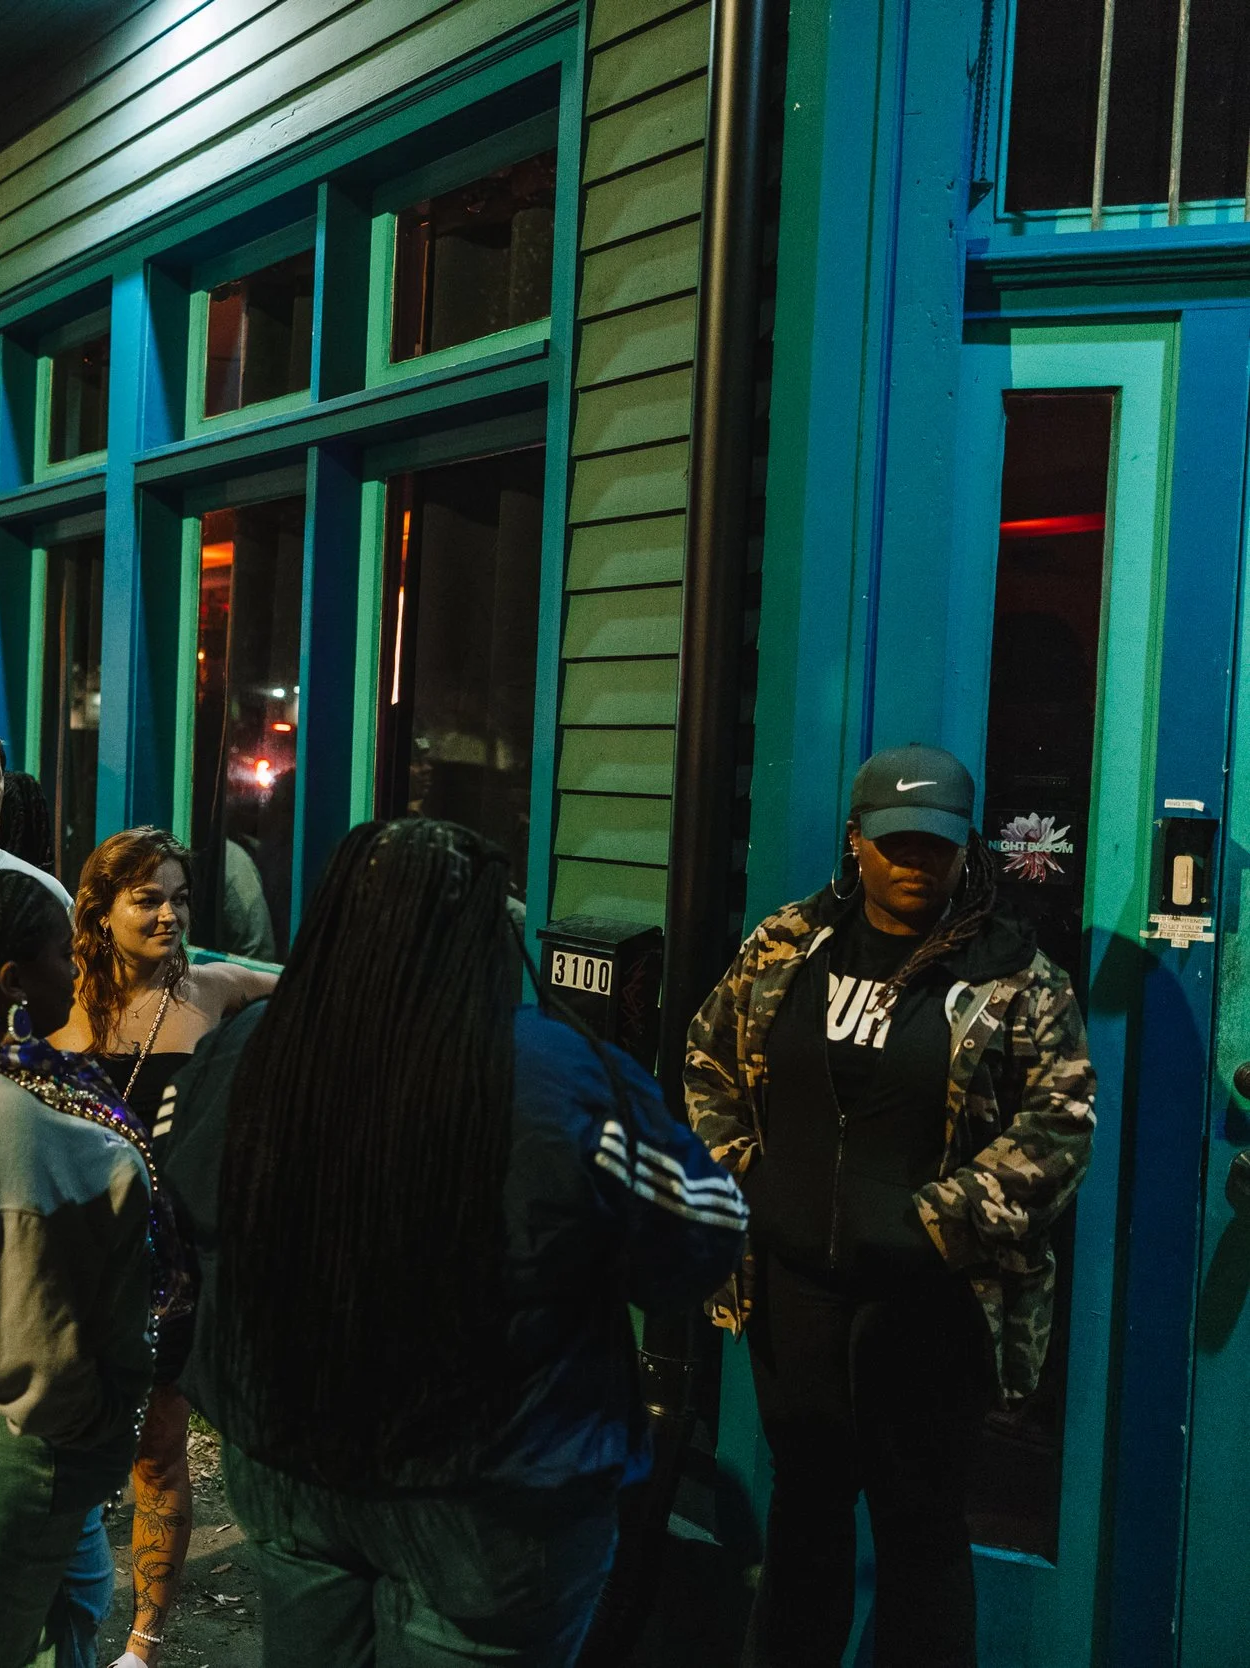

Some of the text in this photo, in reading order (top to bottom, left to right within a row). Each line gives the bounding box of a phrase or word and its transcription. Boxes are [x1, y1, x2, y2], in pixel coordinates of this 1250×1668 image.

[988, 840, 1074, 853] NIGHT BLOOM
[555, 954, 610, 993] 3100
